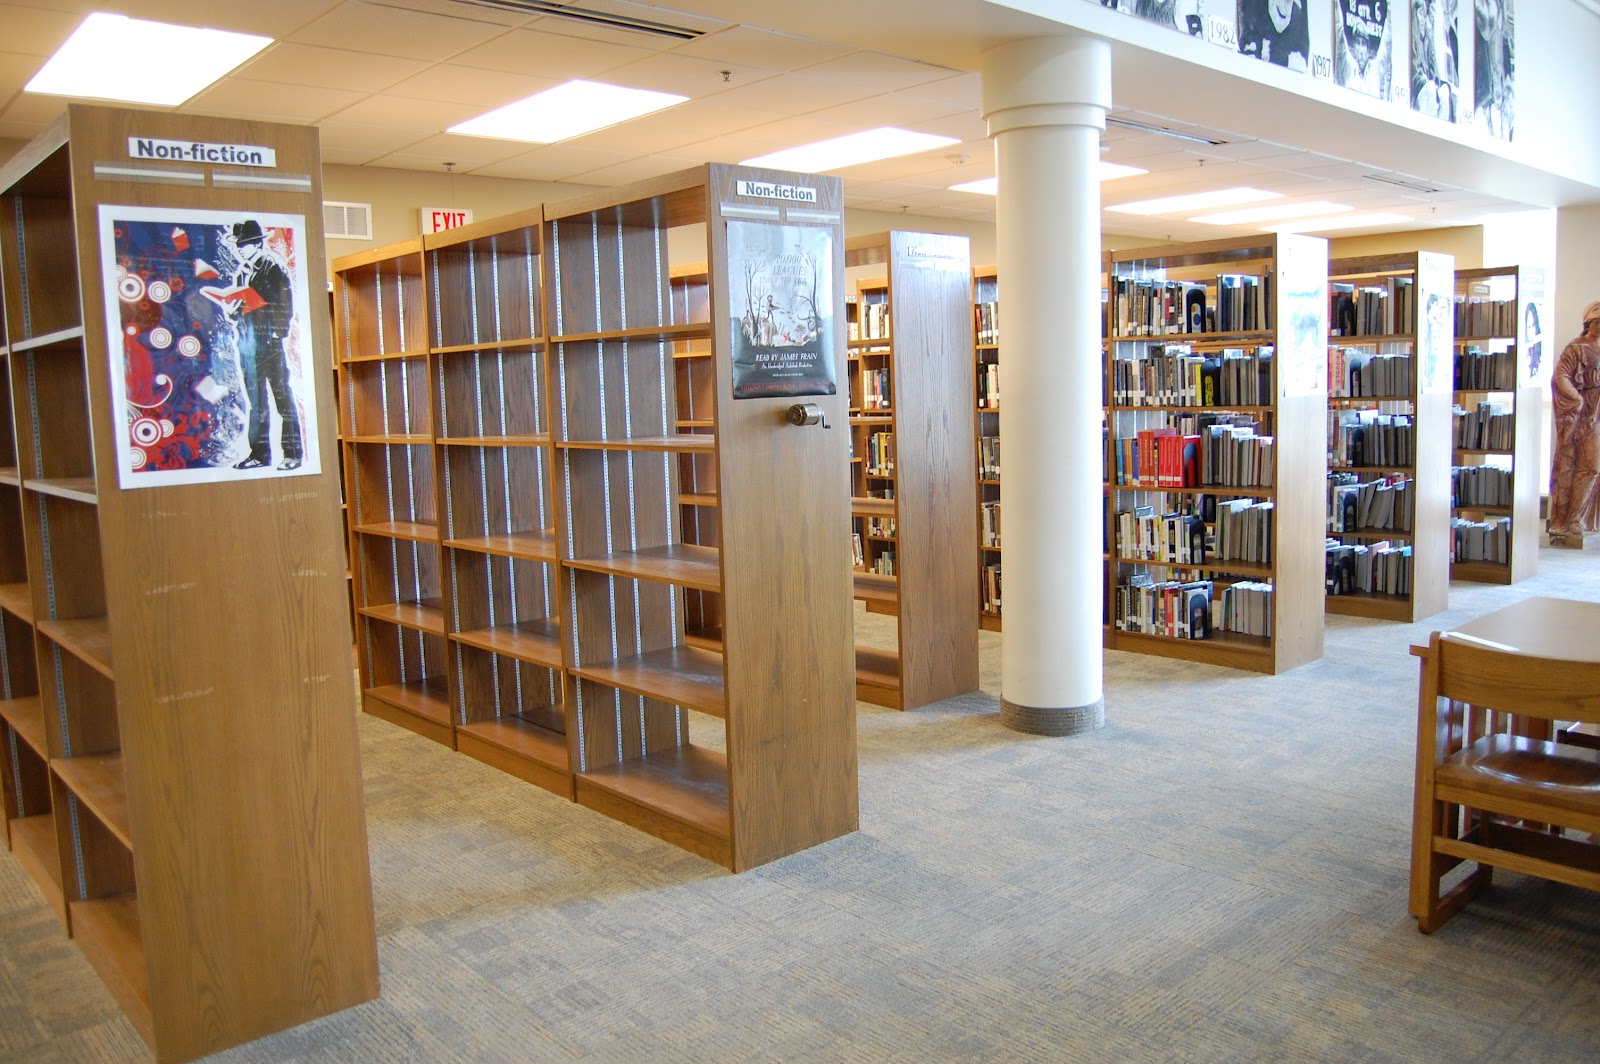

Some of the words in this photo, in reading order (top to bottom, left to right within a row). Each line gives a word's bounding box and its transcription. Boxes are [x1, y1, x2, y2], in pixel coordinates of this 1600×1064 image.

[1210, 20, 1236, 45] 1982
[1314, 54, 1331, 78] 1987
[137, 139, 262, 165] Non-fiction
[745, 181, 813, 201] Non-fiction
[432, 211, 466, 233] EXIT
[772, 265, 808, 277] LEAGUES
[755, 353, 770, 362] READ
[771, 353, 779, 361] BY
[780, 352, 799, 361] JAMES
[800, 352, 818, 361] FRAIN
